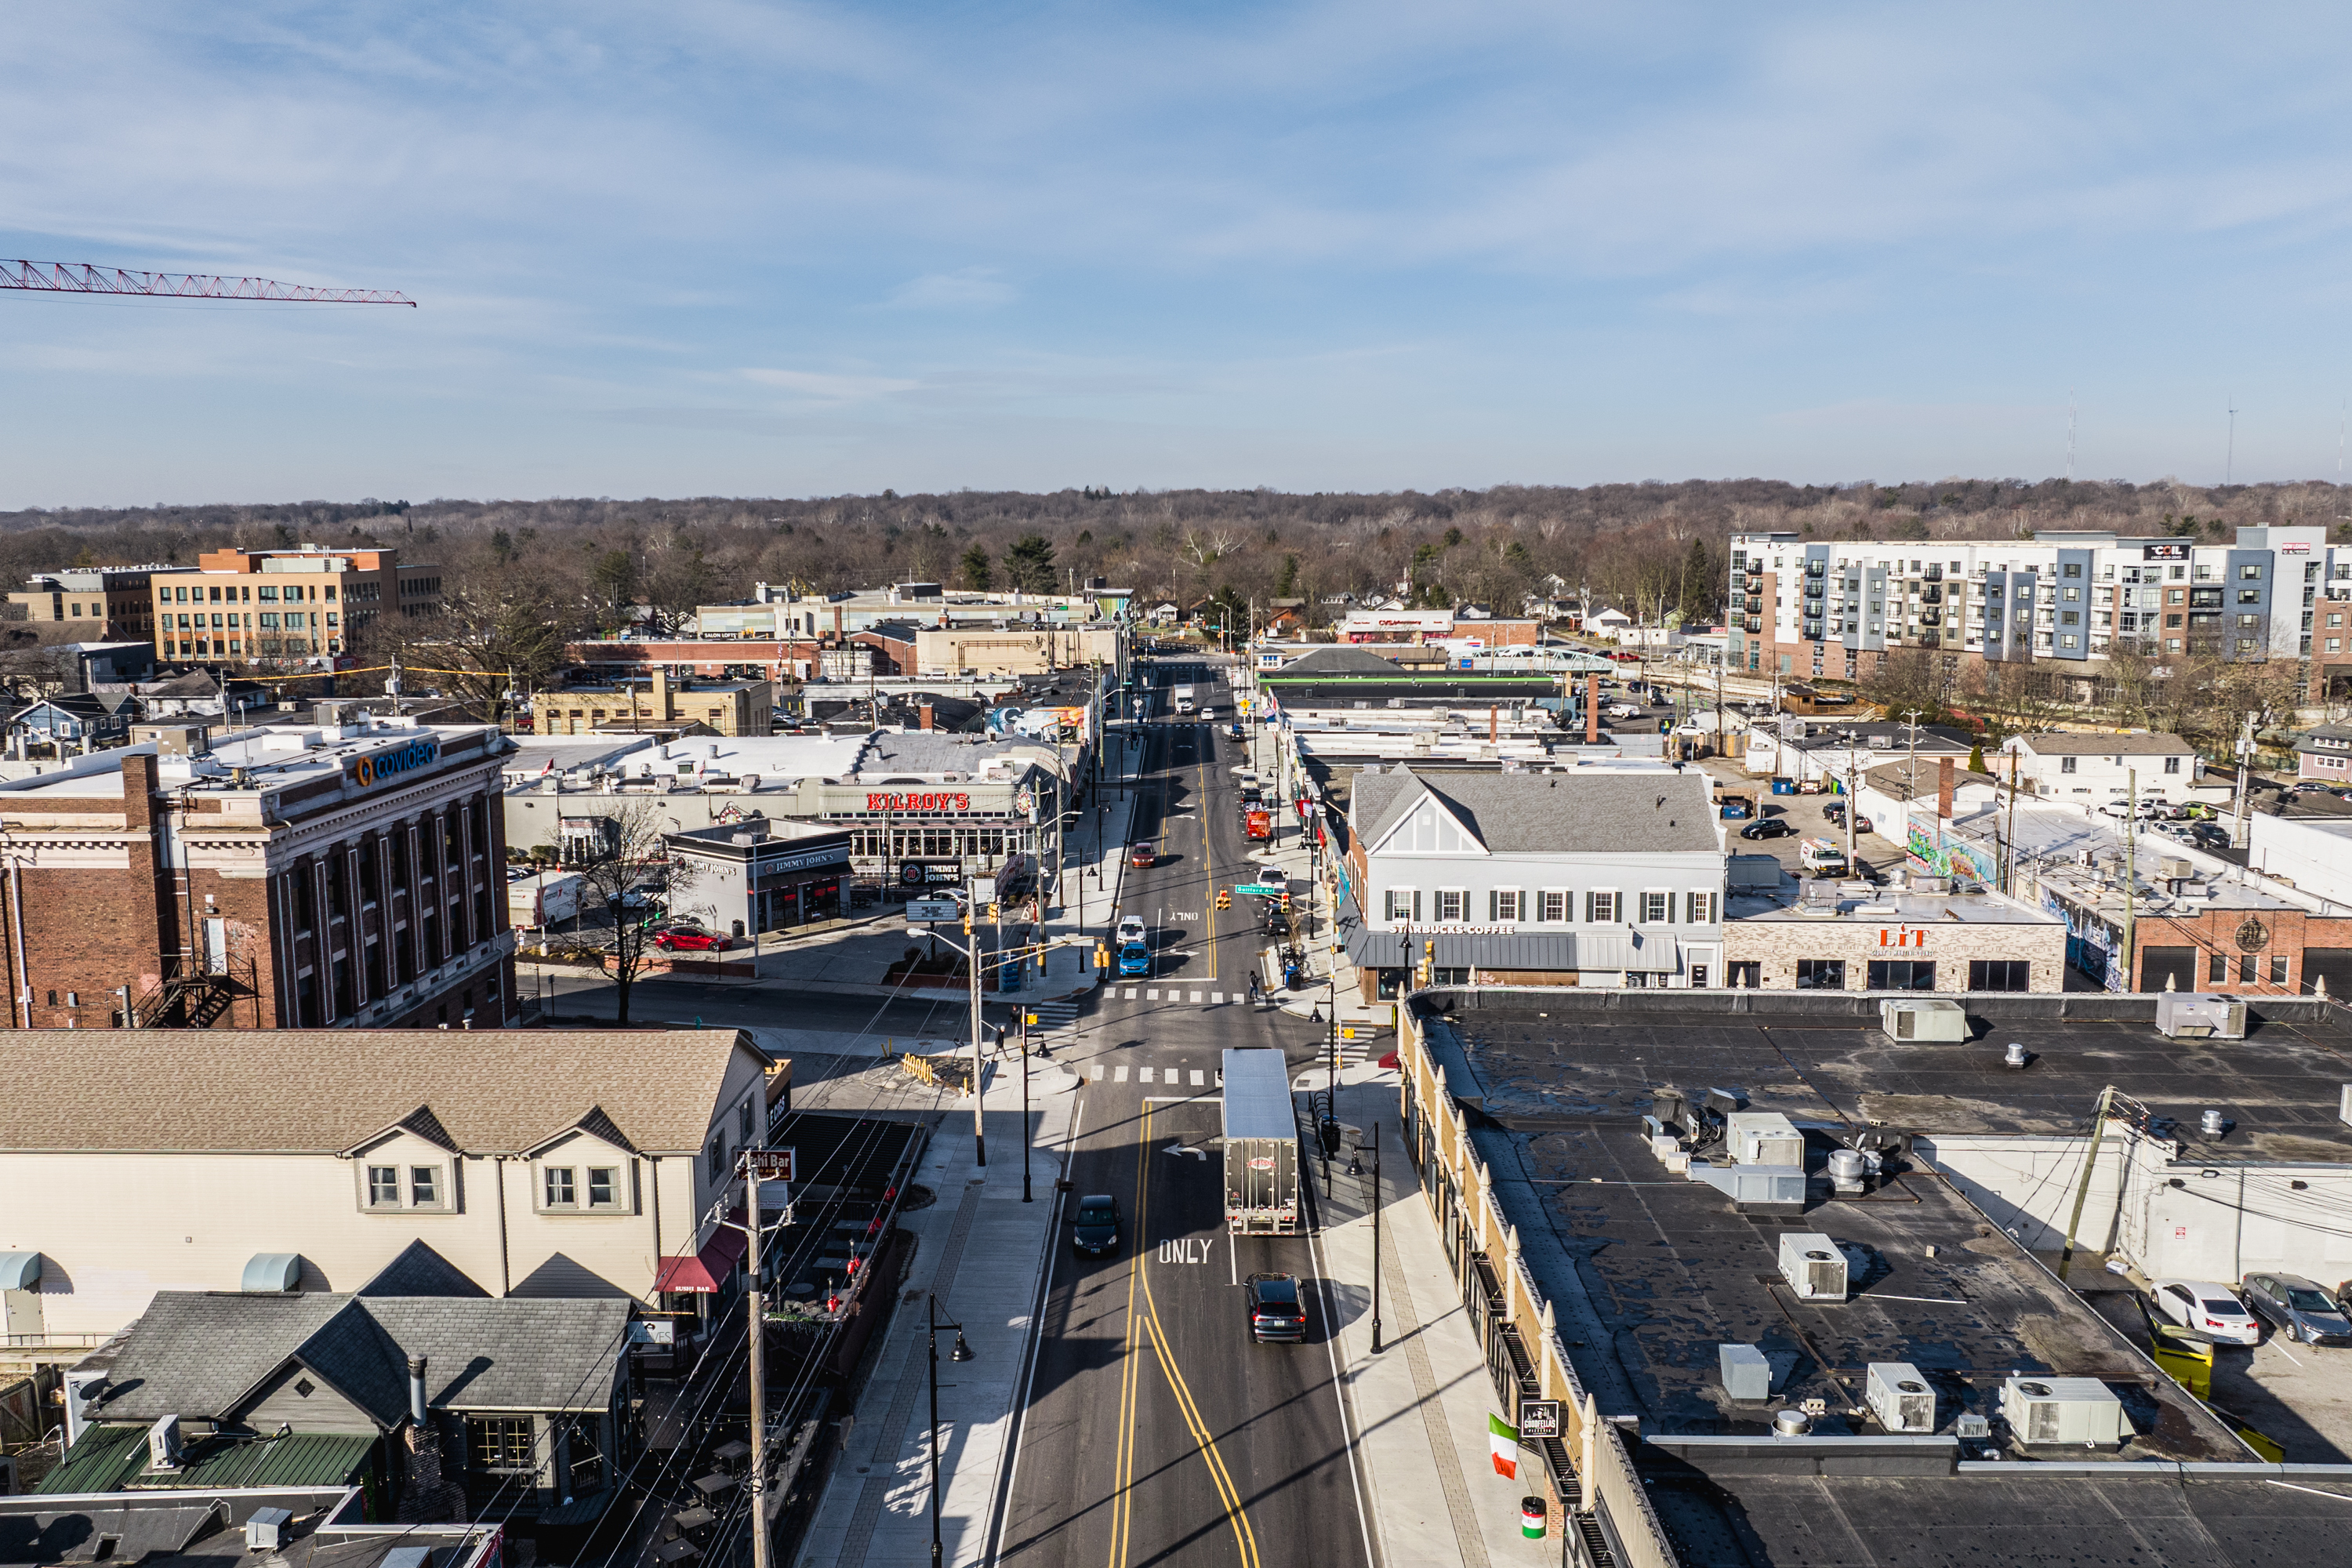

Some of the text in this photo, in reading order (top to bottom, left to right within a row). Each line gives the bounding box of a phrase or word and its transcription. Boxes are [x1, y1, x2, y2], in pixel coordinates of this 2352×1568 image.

[2155, 546, 2183, 555] COIL
[376, 739, 435, 779] covideo
[867, 793, 970, 811] KILROY'S
[776, 854, 834, 872] JIMMY JOHN'S
[710, 863, 737, 876] JOHN'S
[924, 866, 959, 874] JIMMY
[924, 874, 959, 883] JOHN'S
[1170, 912, 1198, 920] ONLY
[1389, 925, 1515, 935] STARBUCKS COFFEE
[2243, 927, 2263, 938] 317
[770, 1154, 789, 1167] Bar
[1160, 1240, 1213, 1264] ONLY
[630, 1331, 672, 1343] THIEVES
[1524, 1419, 1555, 1429] GOODFELLAS
